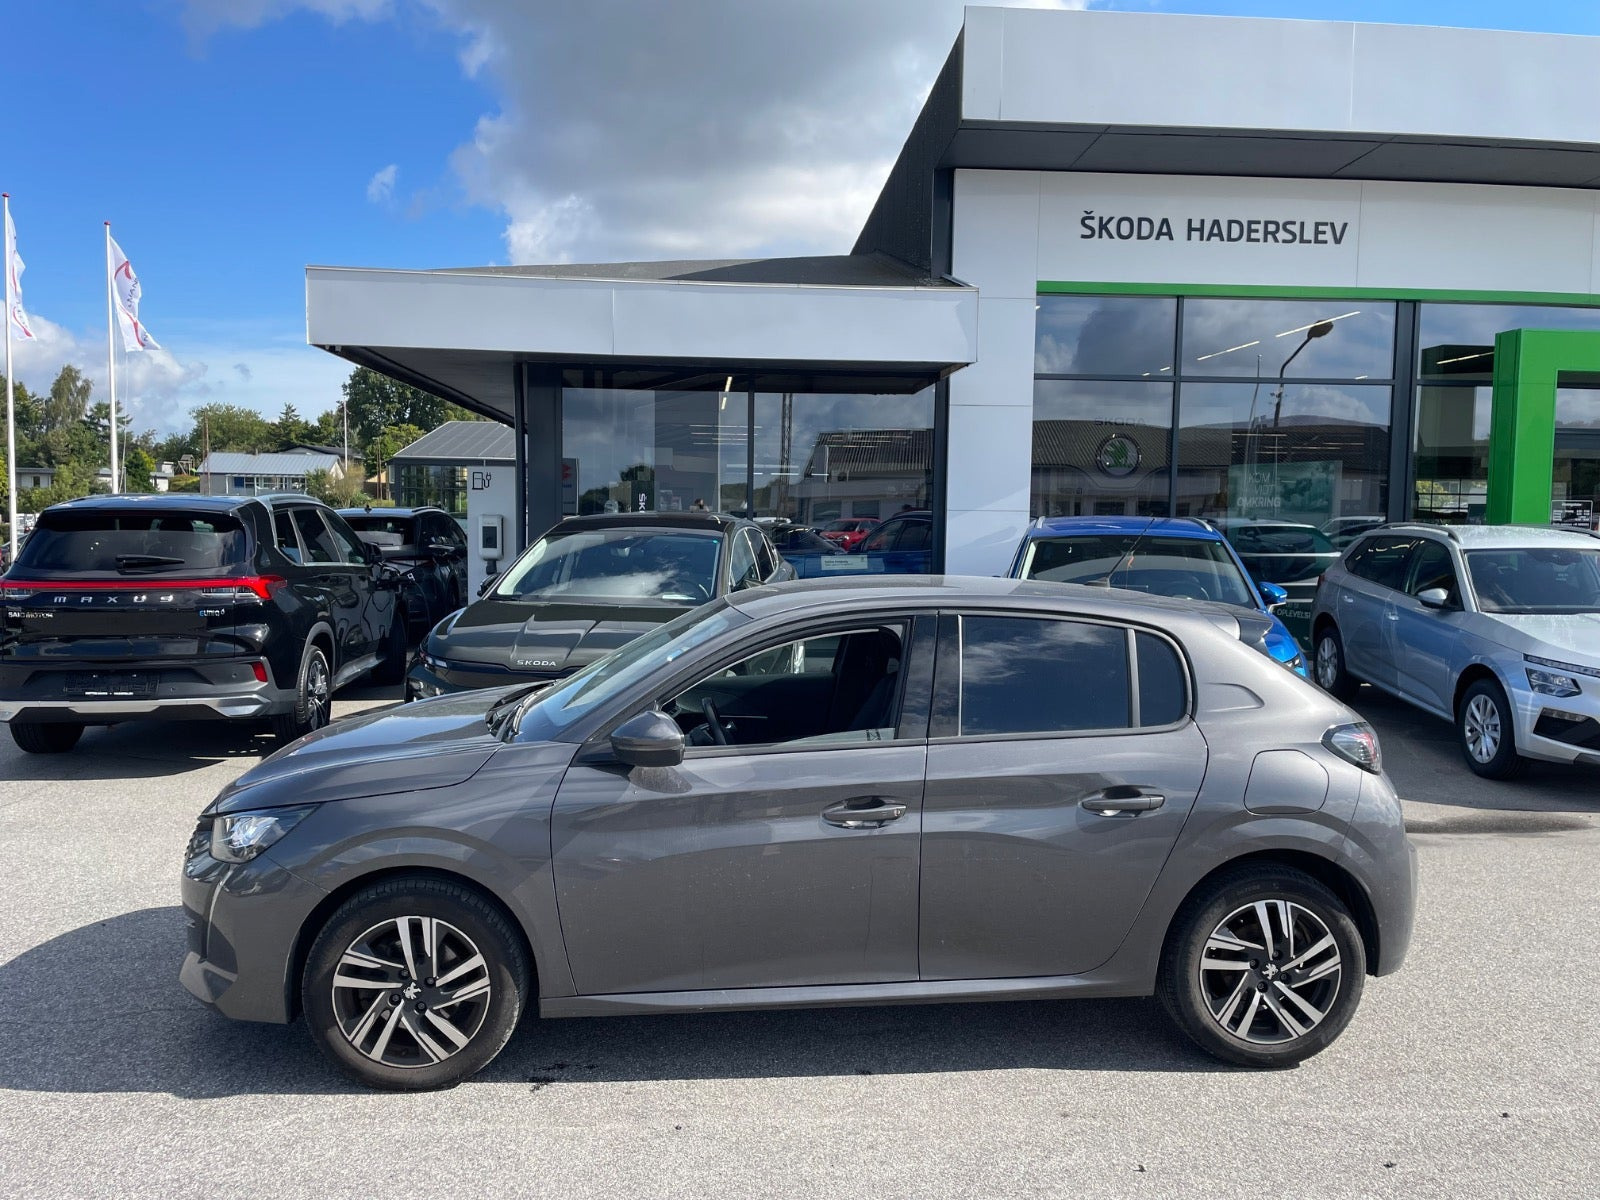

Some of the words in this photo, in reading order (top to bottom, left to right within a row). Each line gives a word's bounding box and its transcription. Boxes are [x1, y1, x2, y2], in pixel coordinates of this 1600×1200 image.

[1080, 210, 1174, 241] ŠKODA
[1186, 219, 1348, 245] HADERSLEV
[1237, 497, 1281, 508] OMKRING
